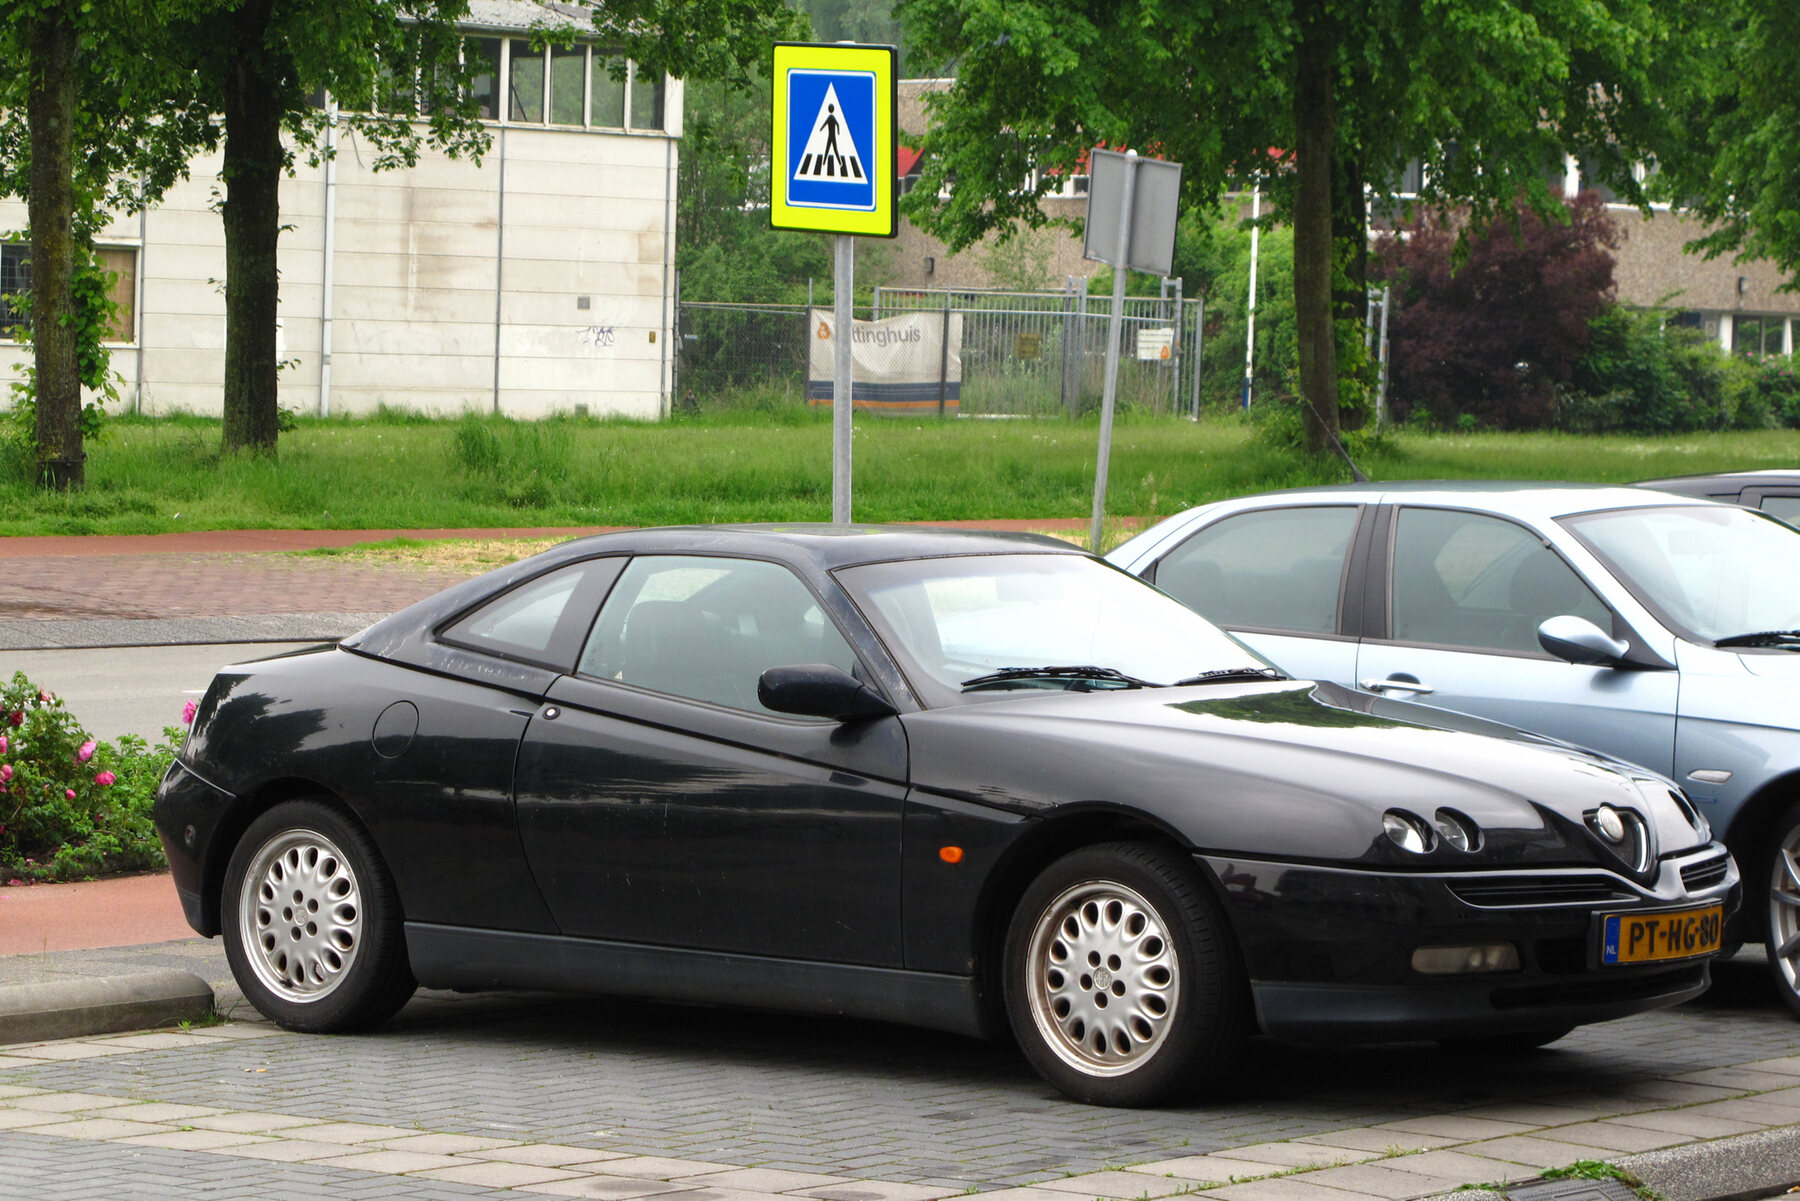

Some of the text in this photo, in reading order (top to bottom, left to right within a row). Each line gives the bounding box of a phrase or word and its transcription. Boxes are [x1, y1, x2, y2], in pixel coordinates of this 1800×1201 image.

[836, 325, 921, 347] ttinghuis
[1629, 912, 1719, 956] PT-HG-80
[1606, 944, 1617, 955] NL
